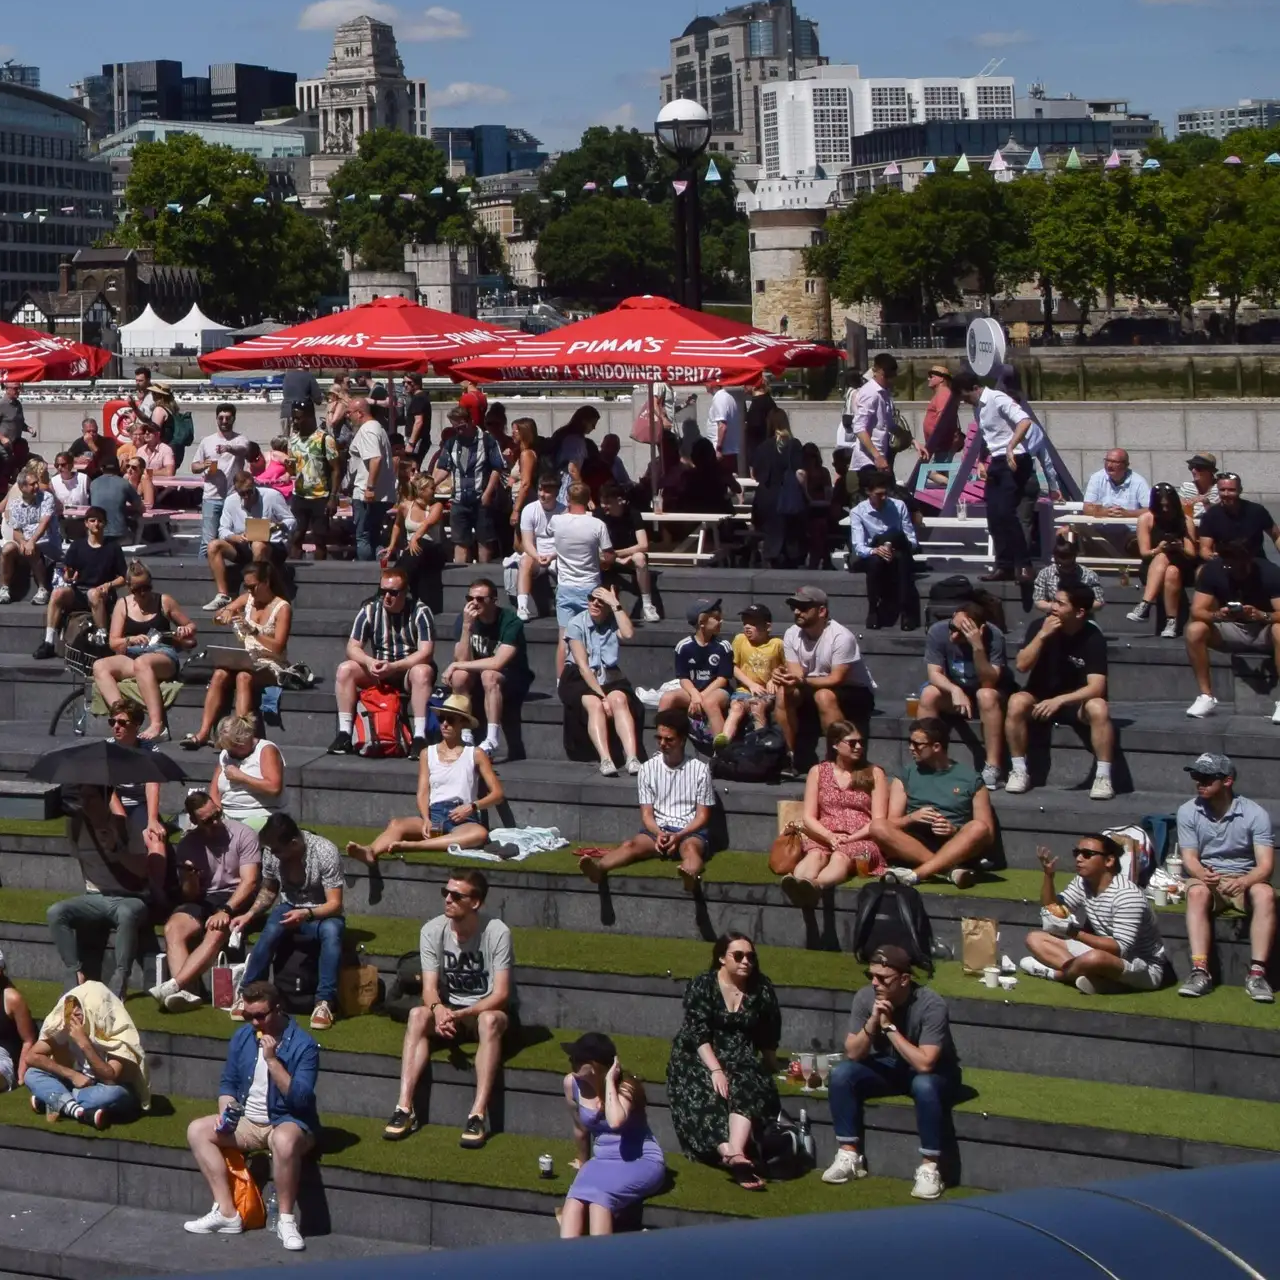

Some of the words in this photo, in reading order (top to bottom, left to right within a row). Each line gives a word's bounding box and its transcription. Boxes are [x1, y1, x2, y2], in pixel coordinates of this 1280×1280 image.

[291, 333, 370, 348] PIMM'S
[567, 336, 664, 354] PIMM'S
[312, 353, 359, 368] O'CLOCK
[532, 365, 558, 380] FOR
[564, 365, 572, 380] A
[576, 363, 662, 381] SUNDOWNER
[443, 950, 484, 971] DAY
